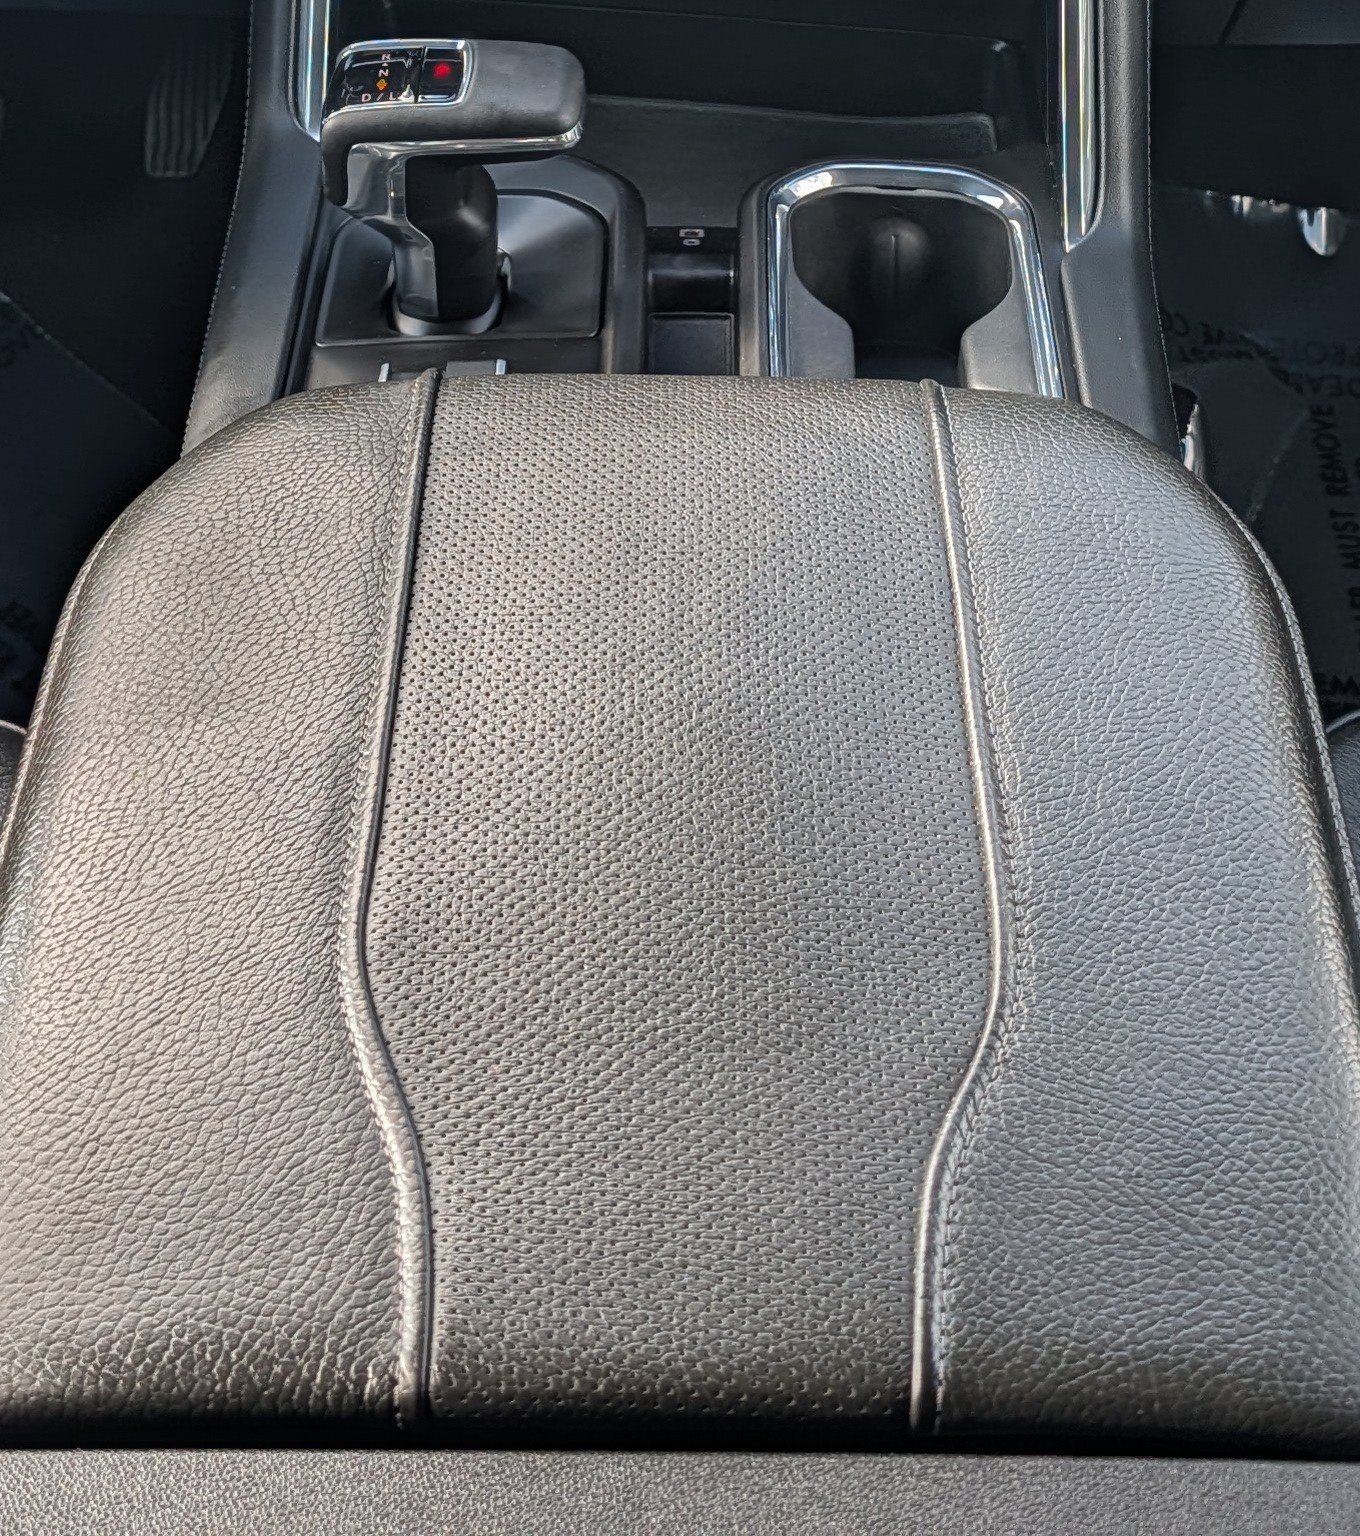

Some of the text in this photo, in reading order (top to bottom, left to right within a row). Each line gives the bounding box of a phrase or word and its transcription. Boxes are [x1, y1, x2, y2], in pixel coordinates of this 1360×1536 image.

[378, 69, 389, 78] N
[361, 93, 372, 102] D
[1310, 402, 1350, 496] REMOVE
